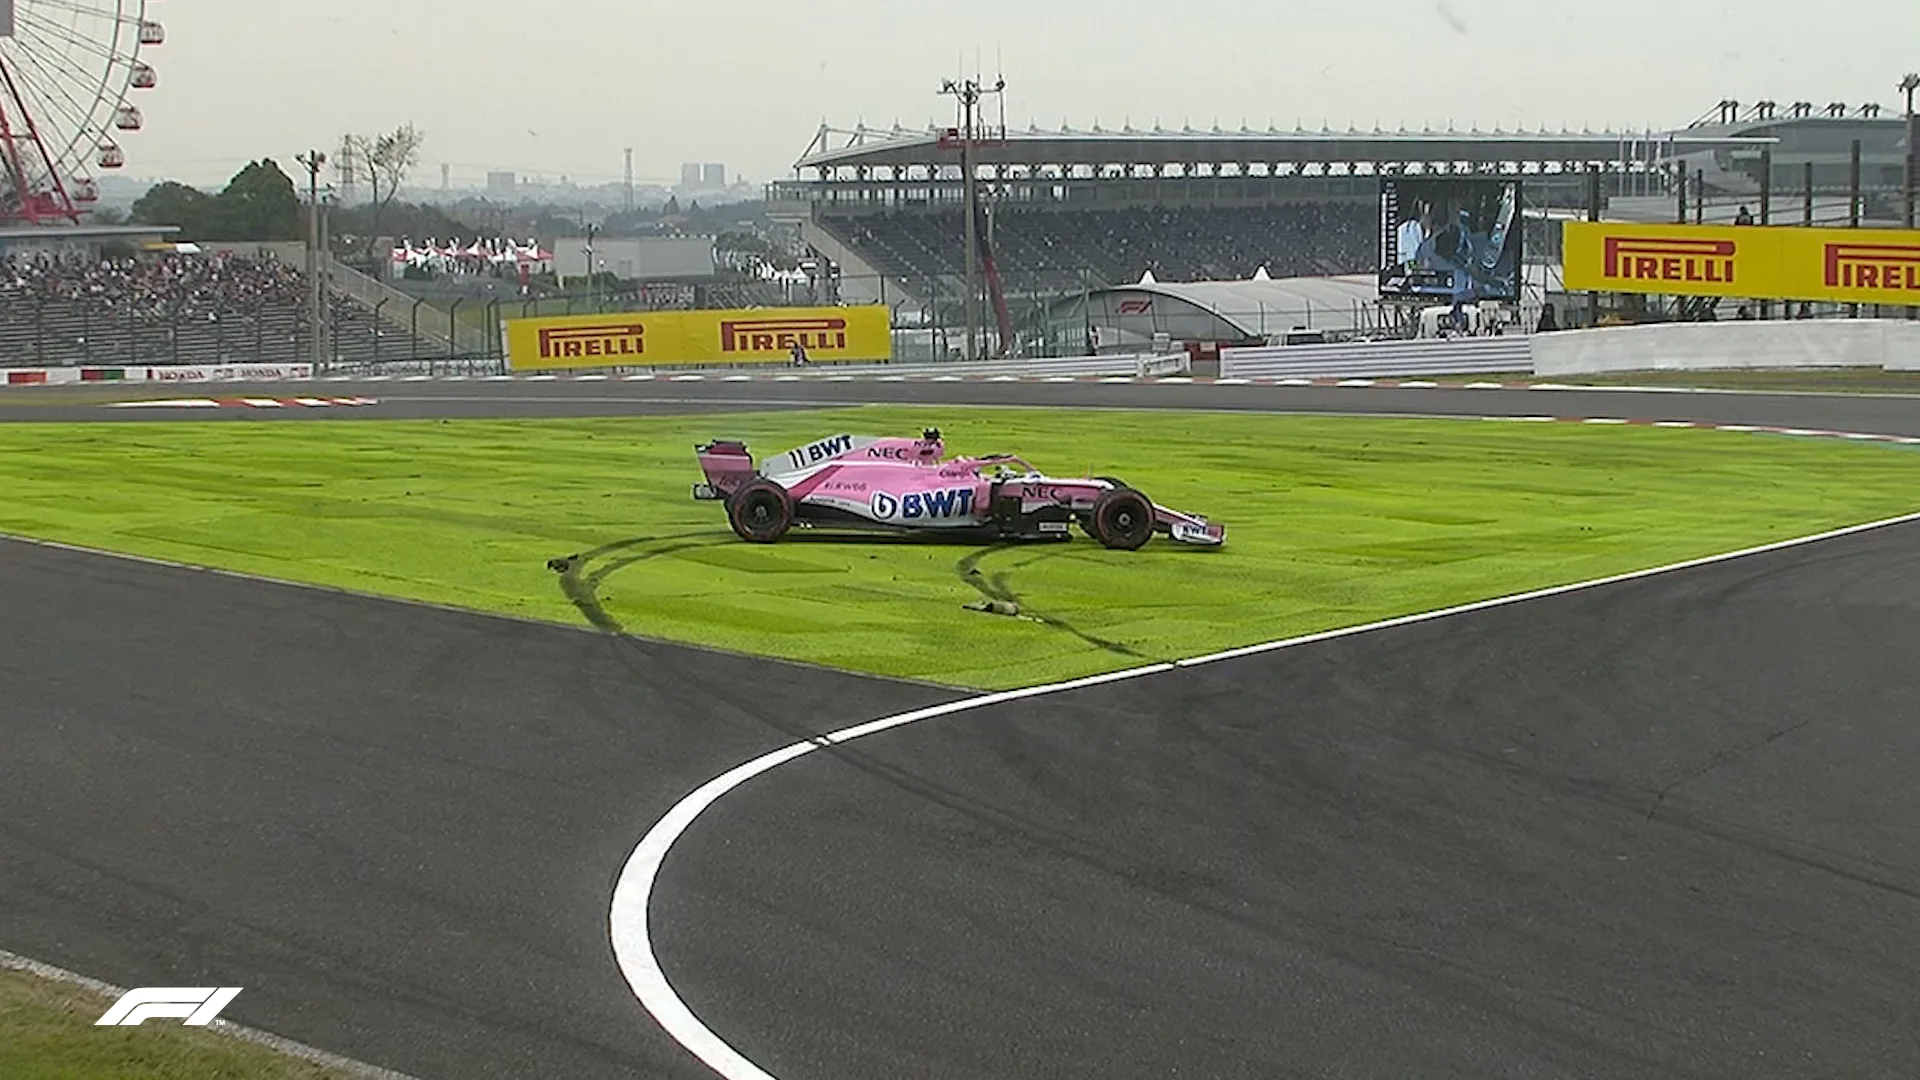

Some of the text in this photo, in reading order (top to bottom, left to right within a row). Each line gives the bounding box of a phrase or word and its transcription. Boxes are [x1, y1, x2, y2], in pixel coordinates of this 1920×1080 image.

[1605, 237, 1736, 282] PIRELLI
[539, 325, 644, 358] PIRELLI
[721, 319, 847, 351] PIRELLI
[789, 450, 805, 468] 11
[810, 435, 852, 462] BWT
[867, 448, 909, 459] NEC
[902, 488, 973, 519] BWT
[1022, 486, 1060, 500] NEC
